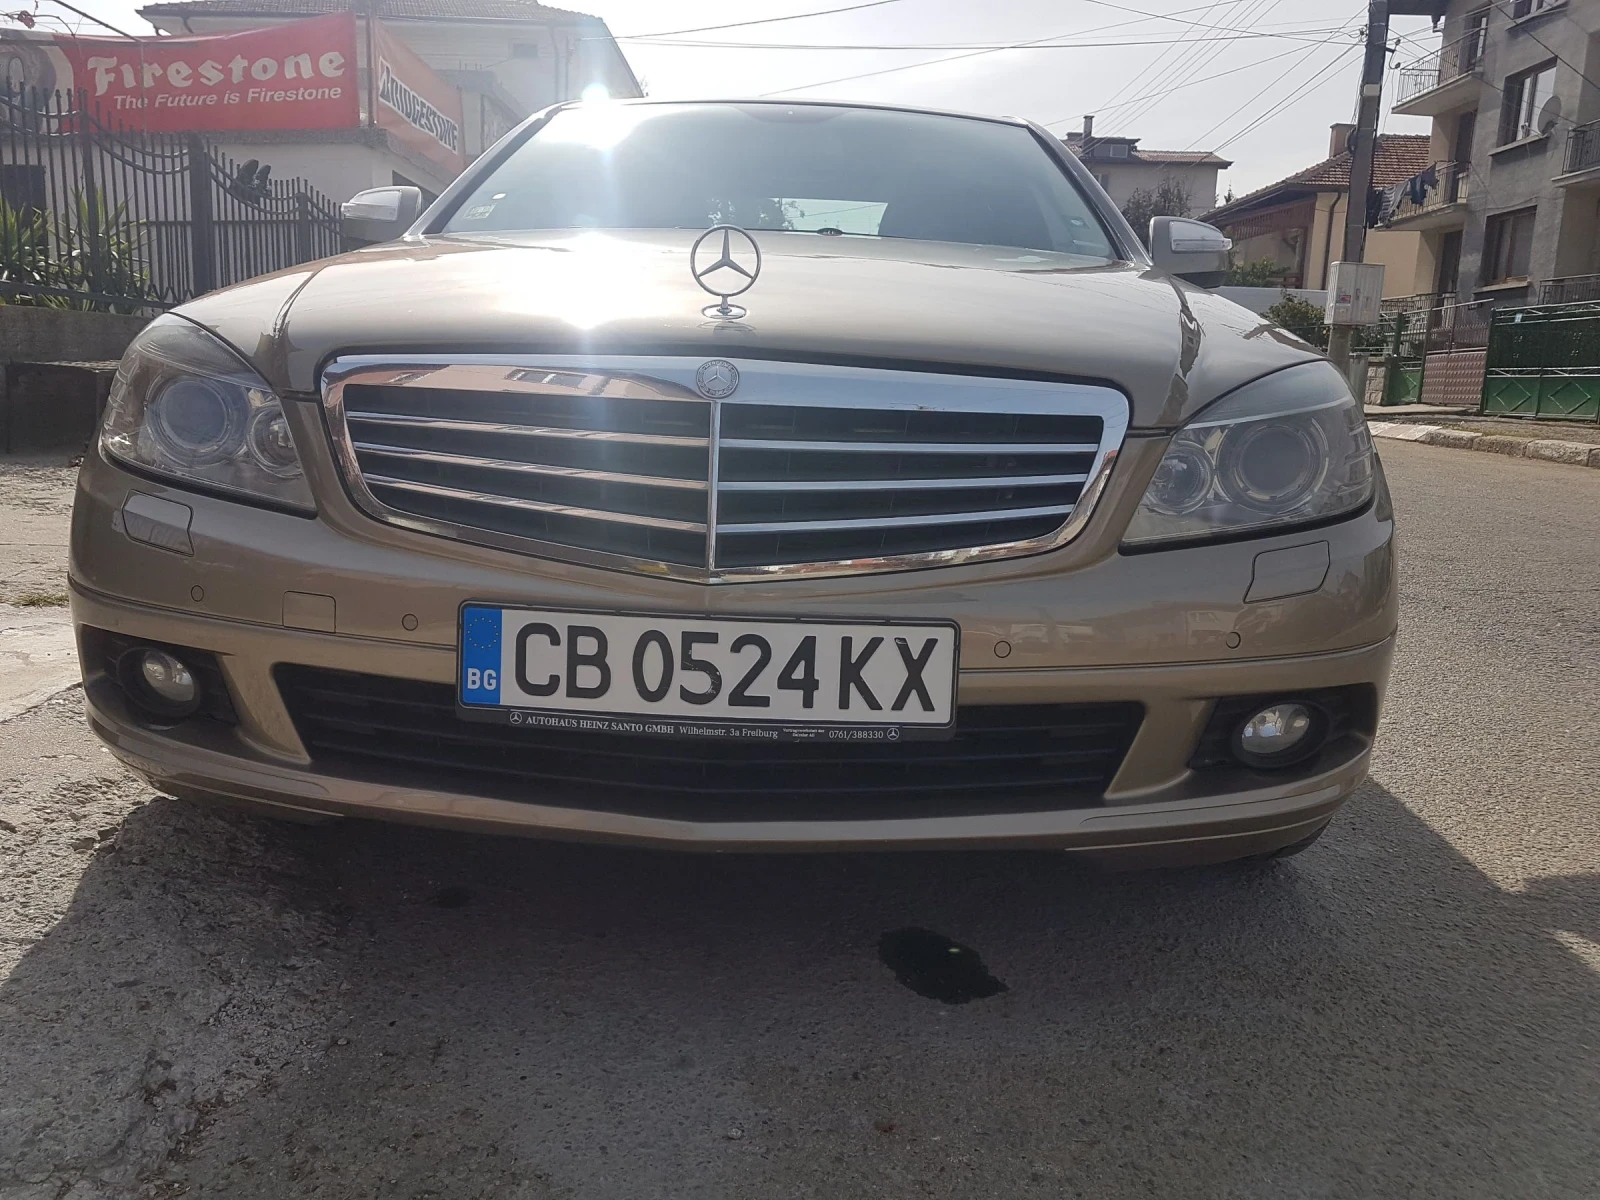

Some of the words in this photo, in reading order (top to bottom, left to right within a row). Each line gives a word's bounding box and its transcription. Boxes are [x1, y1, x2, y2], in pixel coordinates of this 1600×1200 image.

[87, 51, 346, 97] Firestone
[114, 95, 147, 110] The
[155, 93, 217, 108] Future
[223, 90, 240, 104] is
[247, 87, 342, 103] Firestone
[379, 56, 458, 155] BRIDGESTONE
[467, 667, 497, 690] BG
[515, 622, 612, 699] CB
[632, 629, 819, 709] 0524
[838, 635, 939, 712] KX
[526, 715, 578, 728] AUTOHAUS
[579, 719, 610, 730] HEINZ
[611, 722, 643, 733] SANTO
[645, 724, 675, 734] GMBH
[679, 725, 728, 737] Wilhelmstr.
[729, 728, 740, 737] 3a
[742, 728, 779, 740] Freiburg
[828, 730, 884, 741] 0761/388330
